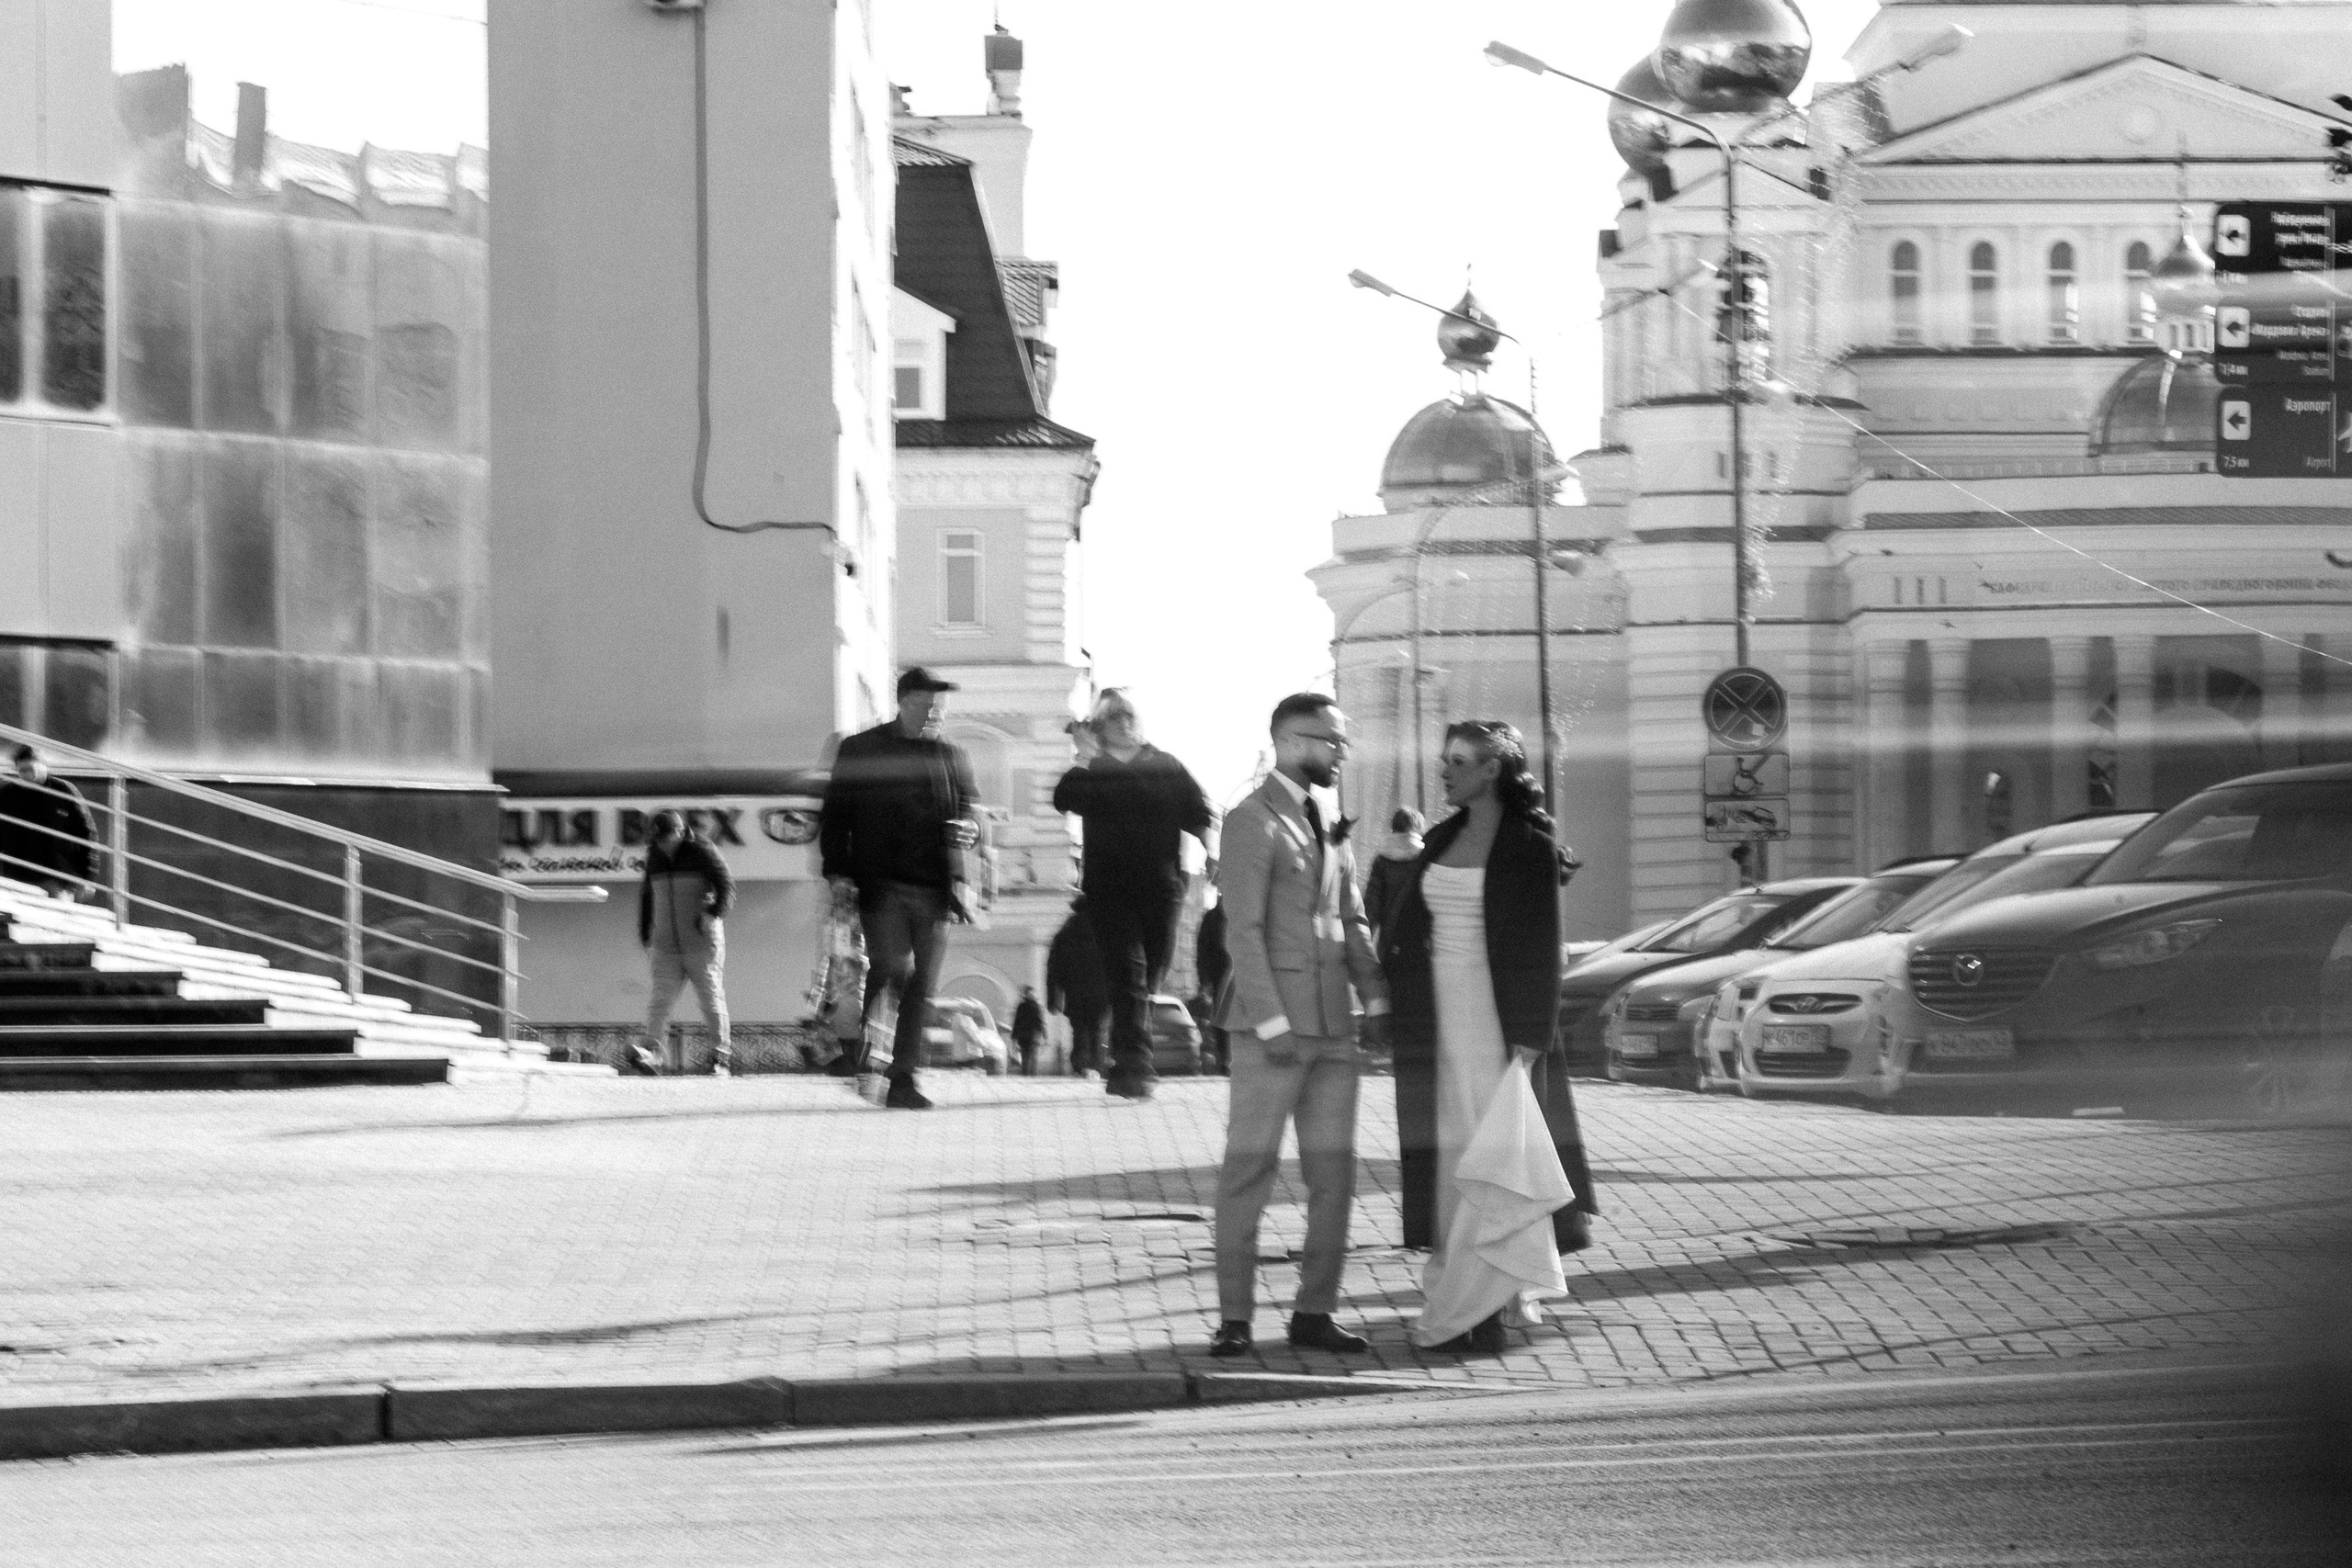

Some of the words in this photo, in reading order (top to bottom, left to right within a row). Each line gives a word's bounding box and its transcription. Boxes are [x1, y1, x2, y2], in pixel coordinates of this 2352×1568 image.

[2284, 398, 2331, 414] Аэропорт
[2306, 457, 2332, 469] Airport
[500, 807, 599, 852] ДЛЯ
[616, 808, 745, 847] ВЕХ
